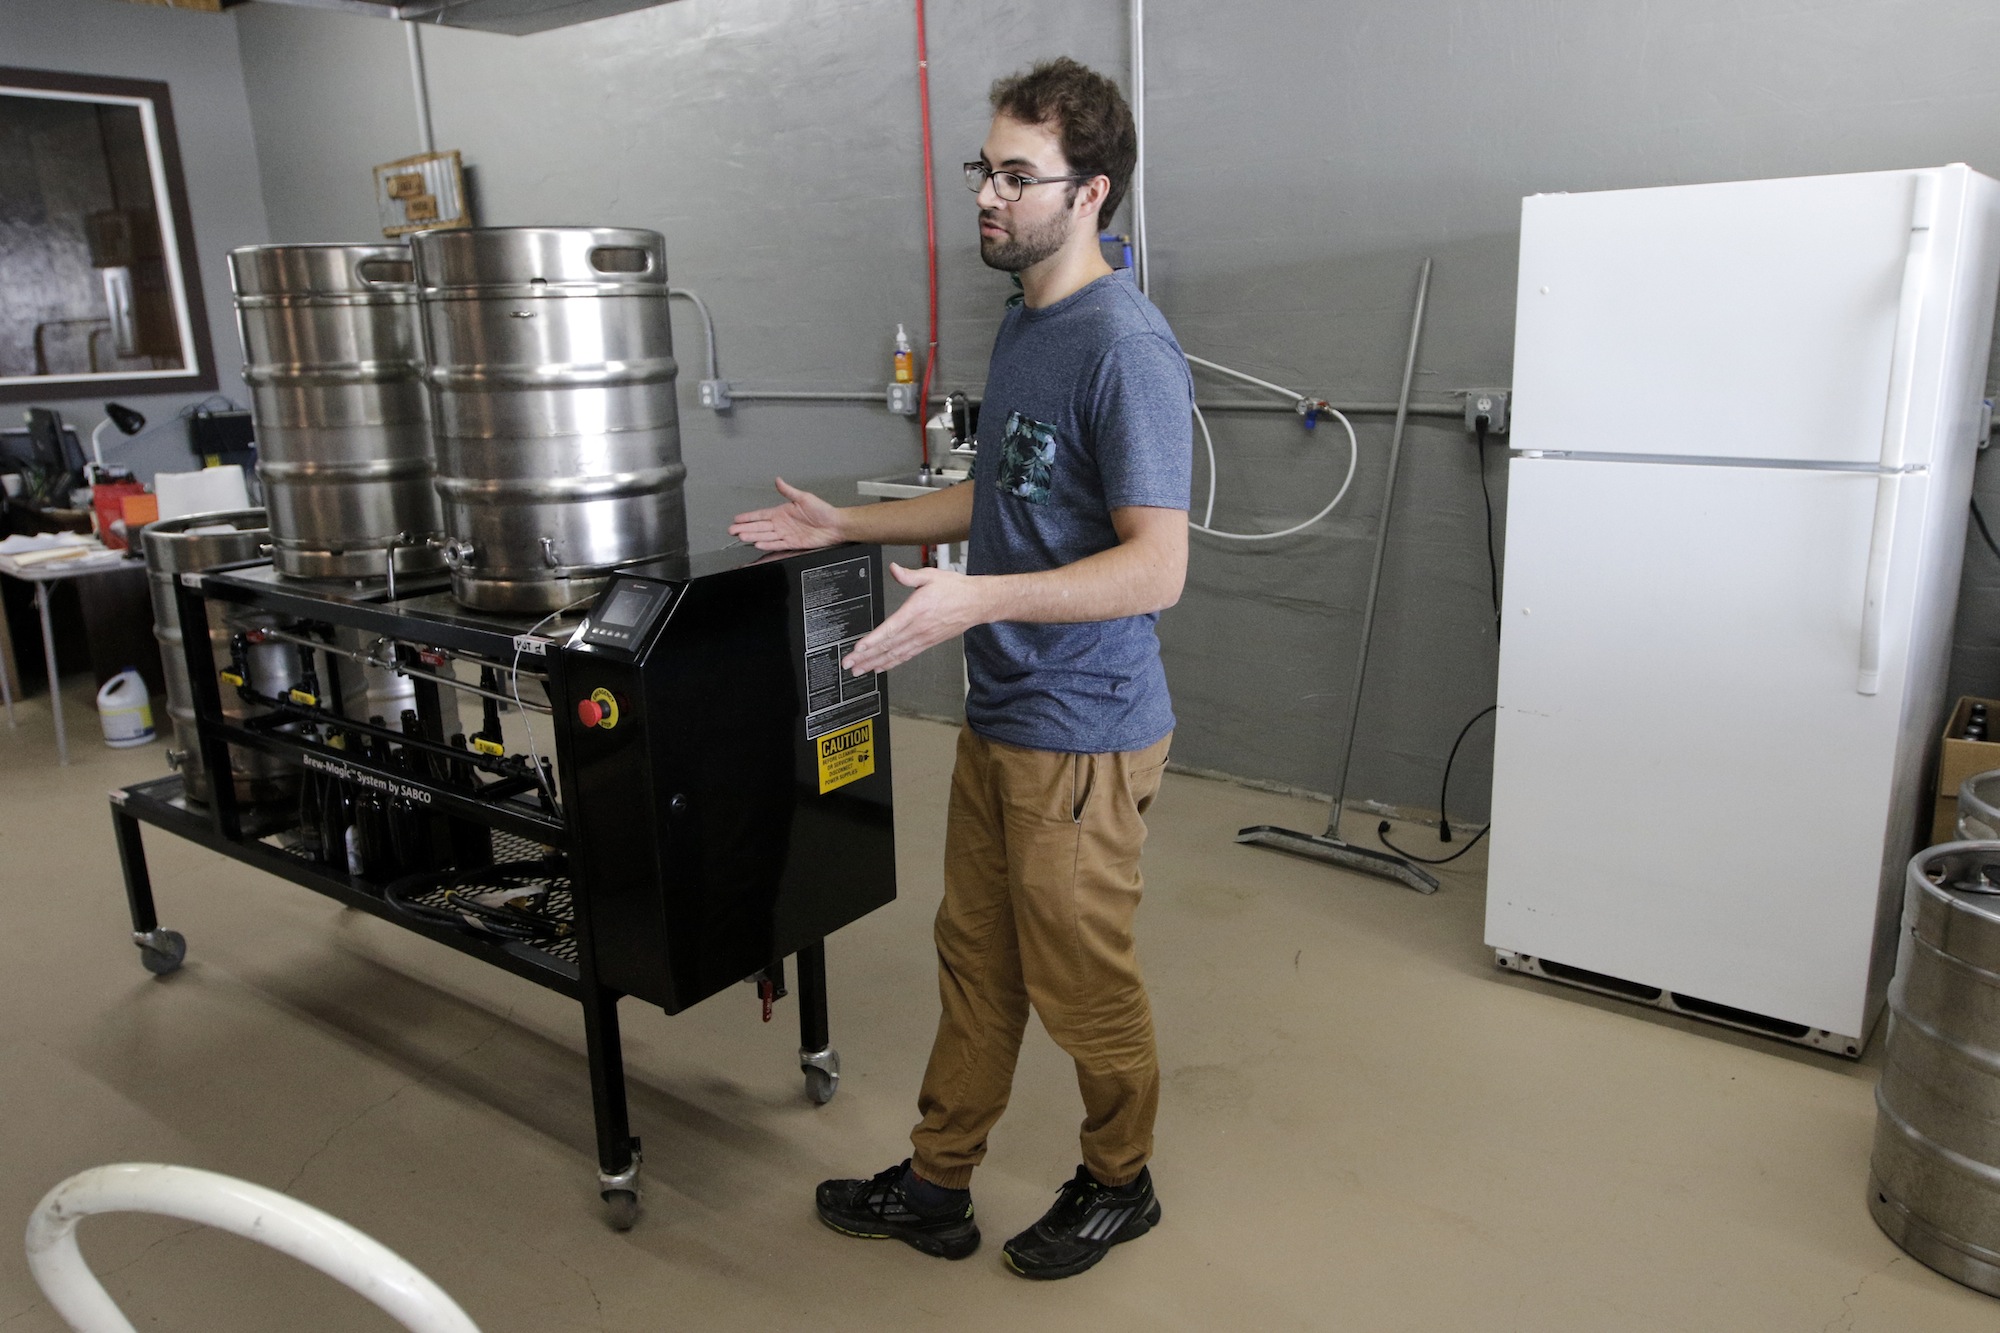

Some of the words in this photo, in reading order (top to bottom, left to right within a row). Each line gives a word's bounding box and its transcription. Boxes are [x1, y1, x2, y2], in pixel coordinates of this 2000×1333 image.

[822, 727, 869, 757] CAUTION
[823, 756, 838, 766] BEFORE
[838, 748, 857, 759] CLEANING
[833, 756, 854, 768] SERVICING
[825, 776, 839, 786] POWER
[840, 769, 858, 779] SUPPLIES
[829, 763, 853, 776] DISCONNECT
[357, 771, 387, 790] System
[388, 780, 399, 796] by
[400, 785, 431, 804] SABCO
